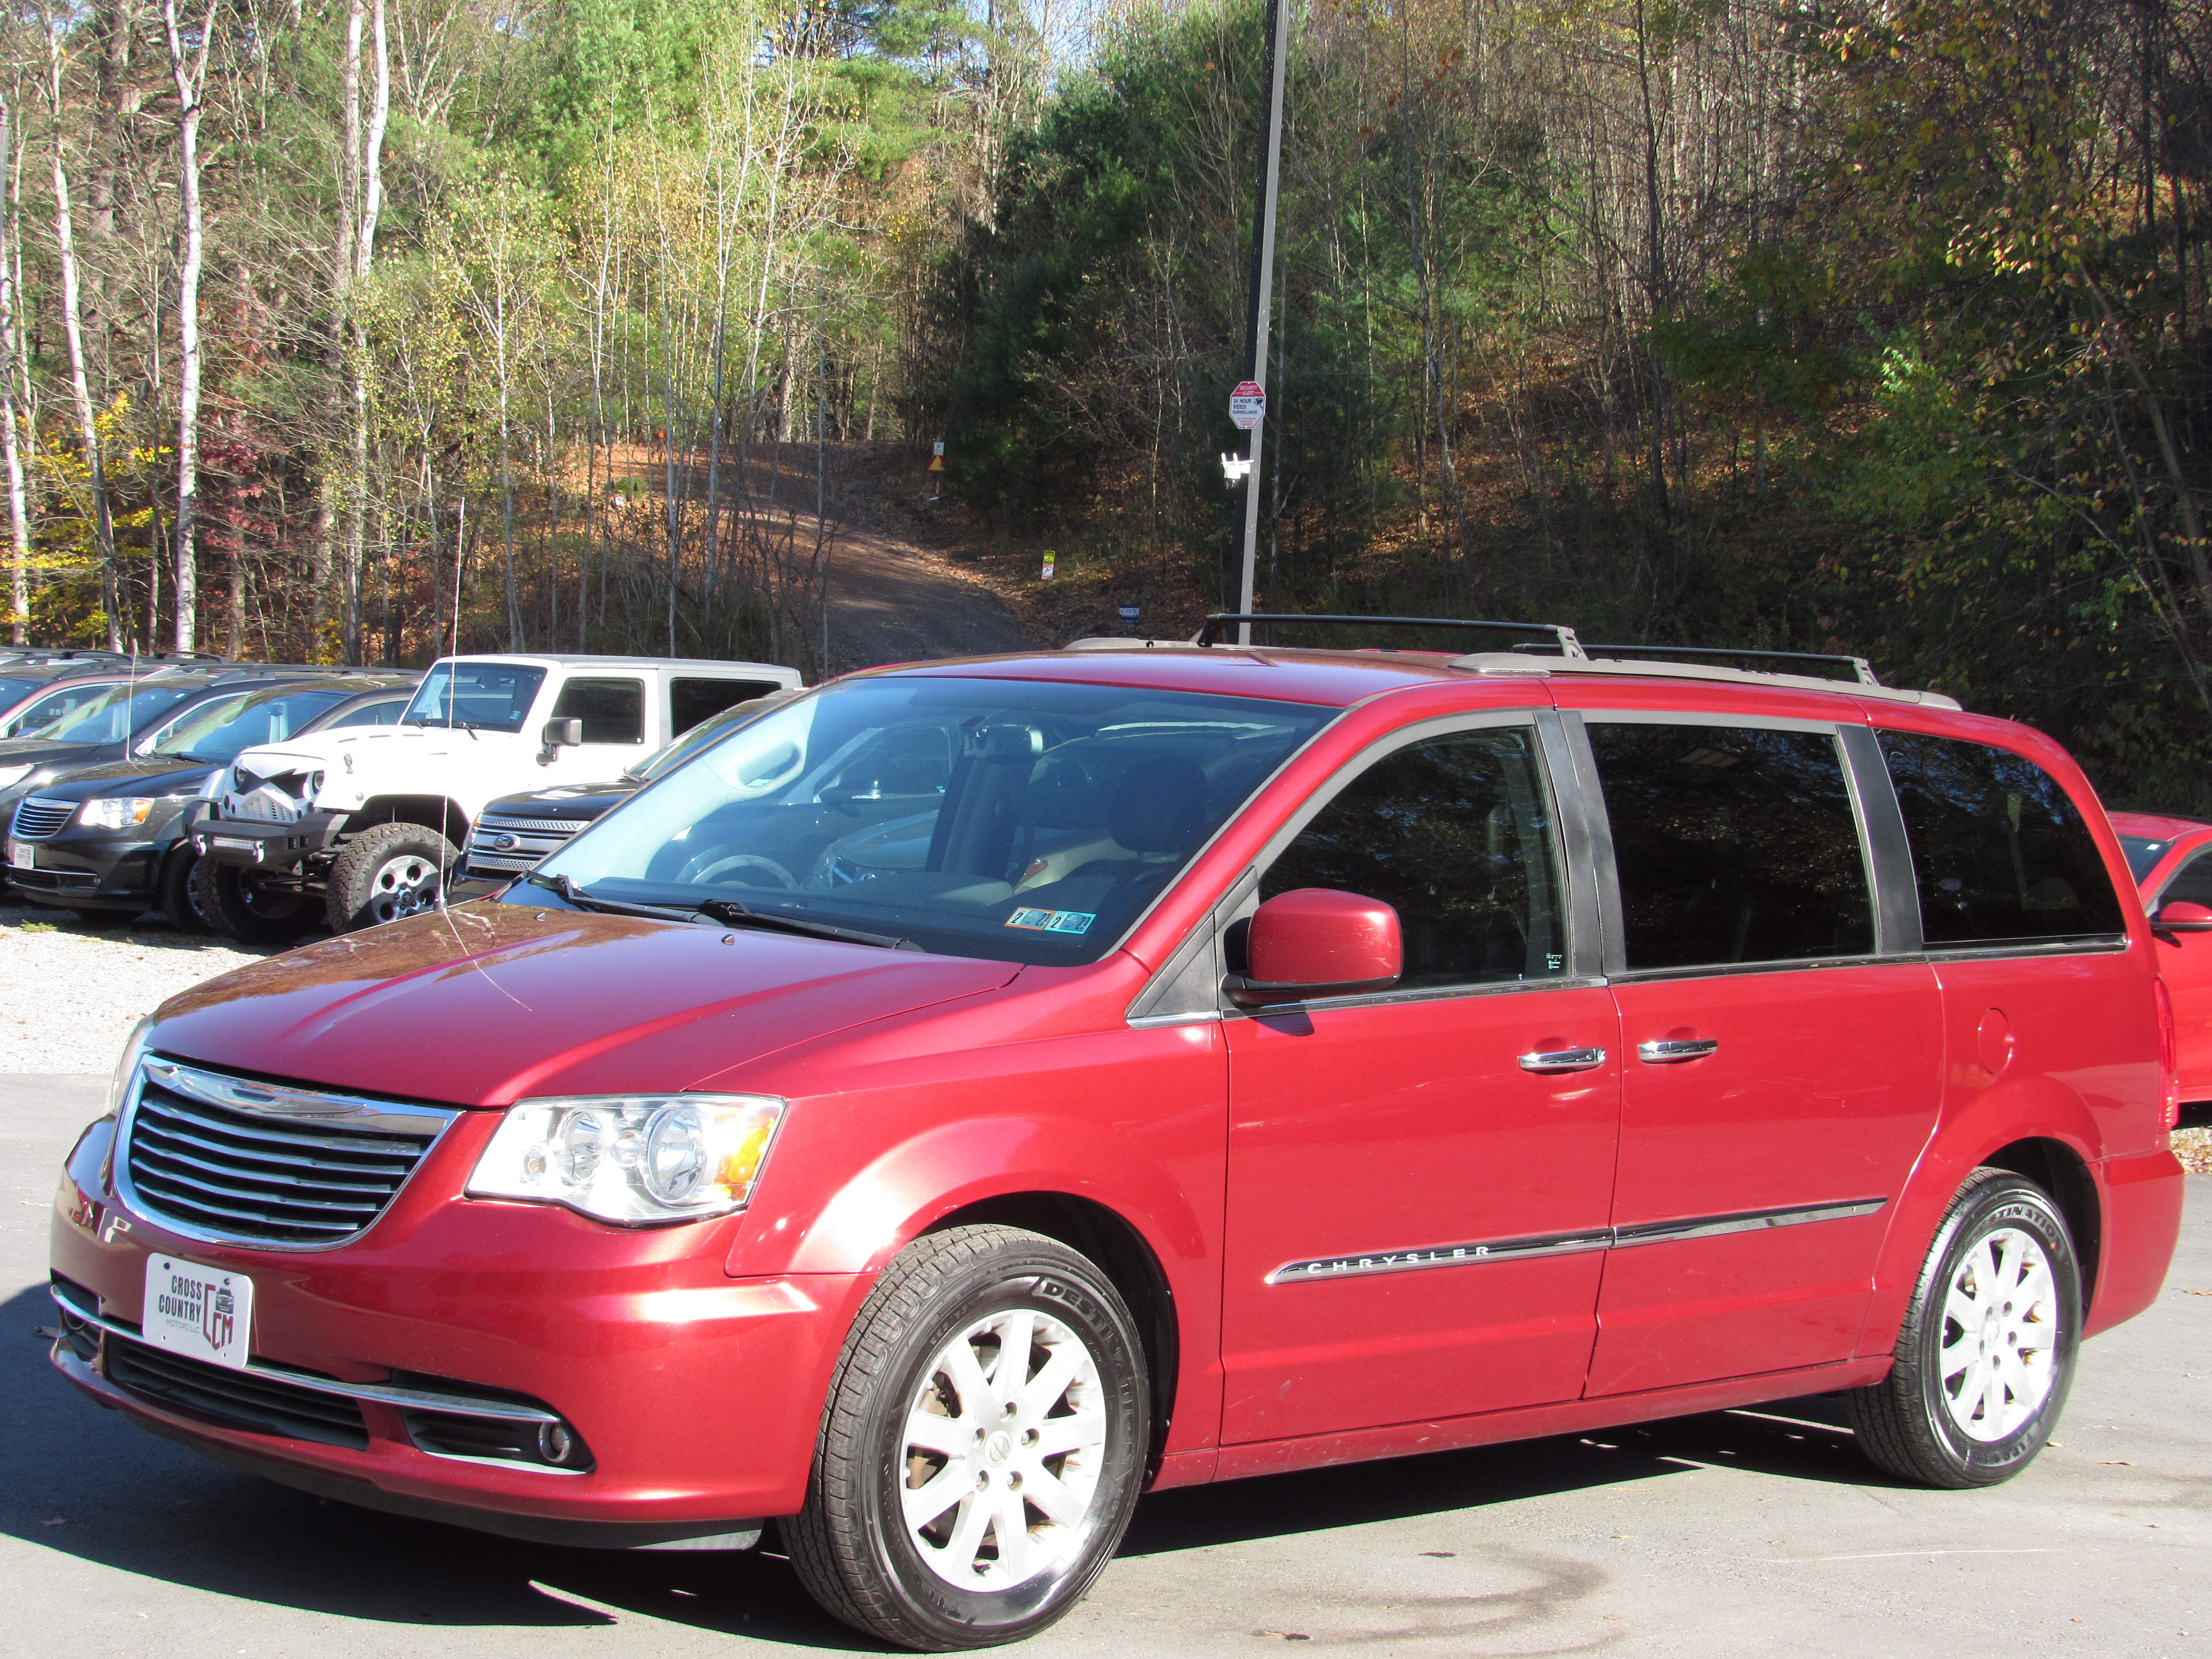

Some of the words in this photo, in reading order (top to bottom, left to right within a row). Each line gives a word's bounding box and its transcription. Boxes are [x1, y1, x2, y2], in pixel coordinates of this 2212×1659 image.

[1011, 913, 1024, 924] 2
[1050, 916, 1062, 928] 2
[1307, 1246, 1489, 1274] CHRYSLER
[172, 1274, 202, 1300] CROSS
[159, 1294, 202, 1323] COUNTRY
[167, 1319, 190, 1331] MOTORS
[190, 1325, 200, 1334] LLC
